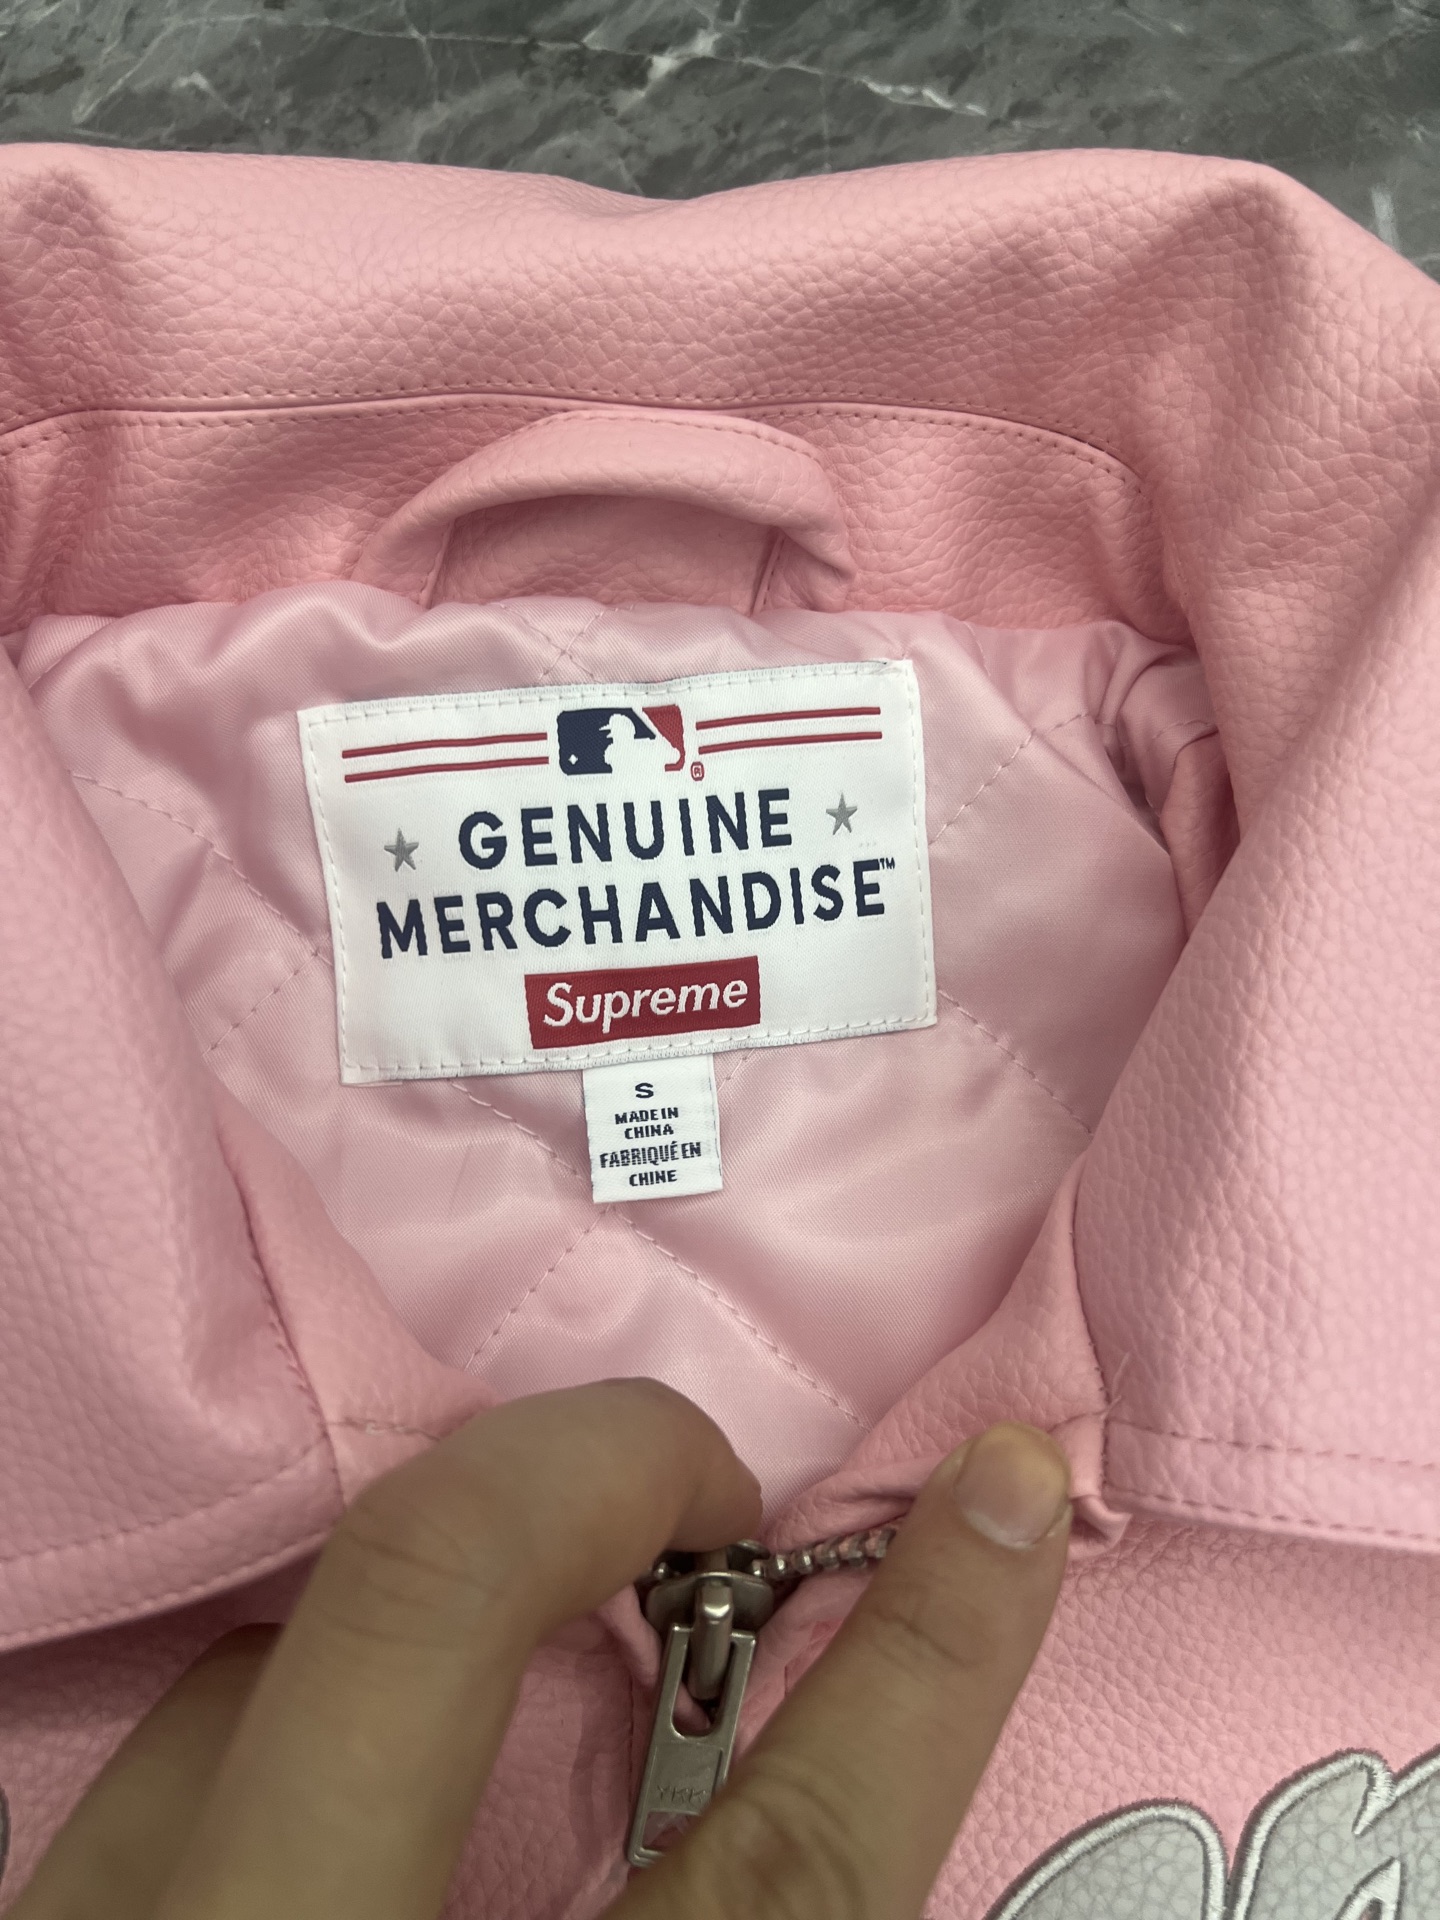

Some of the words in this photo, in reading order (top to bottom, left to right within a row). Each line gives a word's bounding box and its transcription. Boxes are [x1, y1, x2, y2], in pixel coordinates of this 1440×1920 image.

[458, 788, 793, 870] GENUINE
[543, 976, 749, 1034] Supreme
[635, 1083, 654, 1098] S
[614, 1108, 658, 1125] MADE
[661, 1107, 679, 1119] IN
[624, 1123, 674, 1140] CHINA
[599, 1141, 680, 1168] FABRIQUÉ
[681, 1141, 702, 1159] EN
[628, 1169, 678, 1187] CHINE
